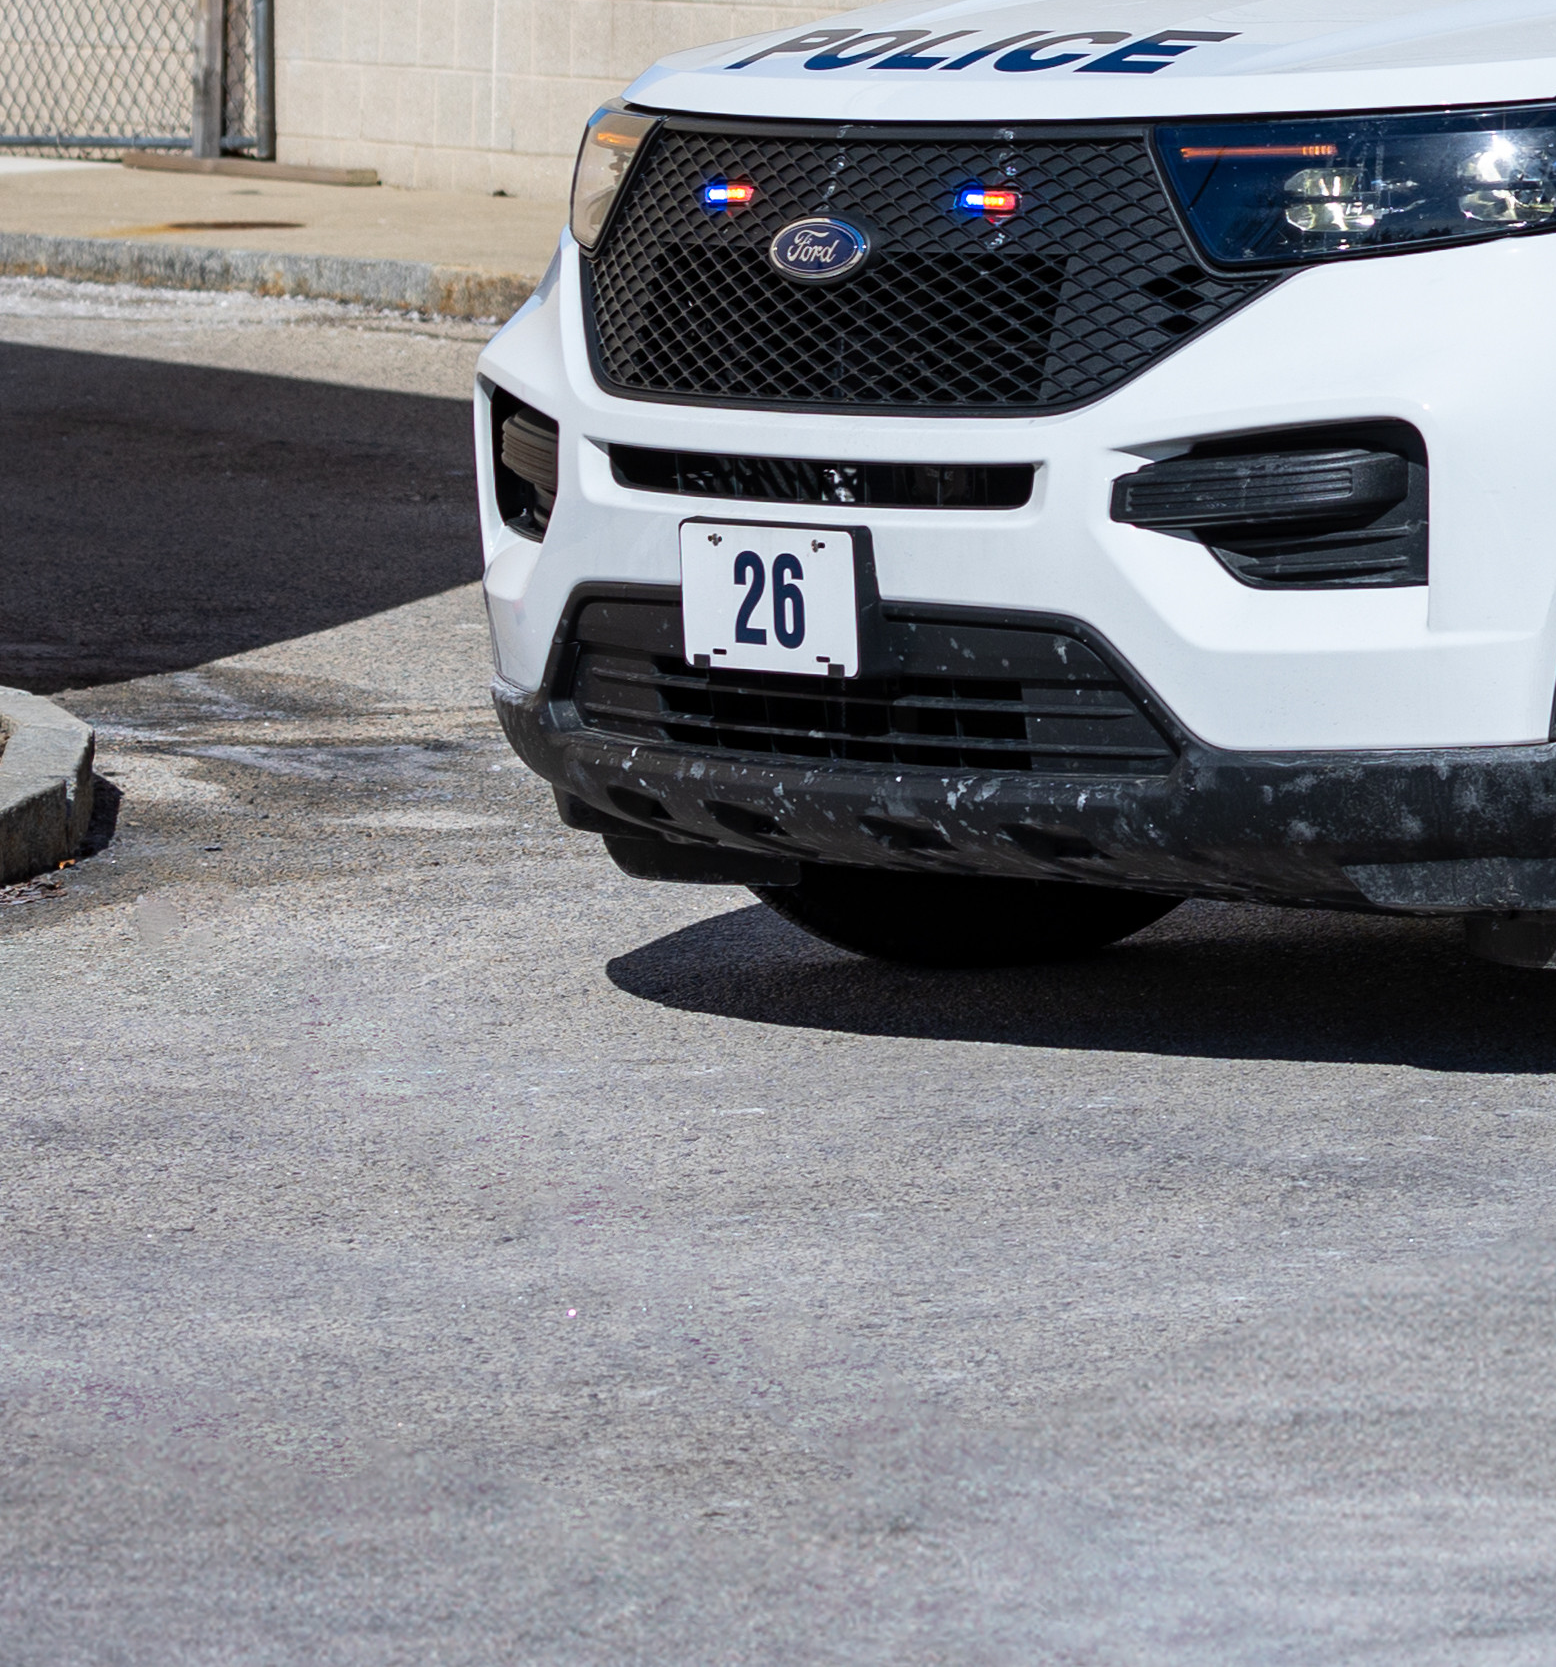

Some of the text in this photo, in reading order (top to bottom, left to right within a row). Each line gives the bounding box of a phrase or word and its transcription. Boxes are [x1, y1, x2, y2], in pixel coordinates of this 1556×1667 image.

[722, 28, 1244, 75] POLICE
[786, 229, 840, 263] Ford
[733, 550, 806, 650] 26
